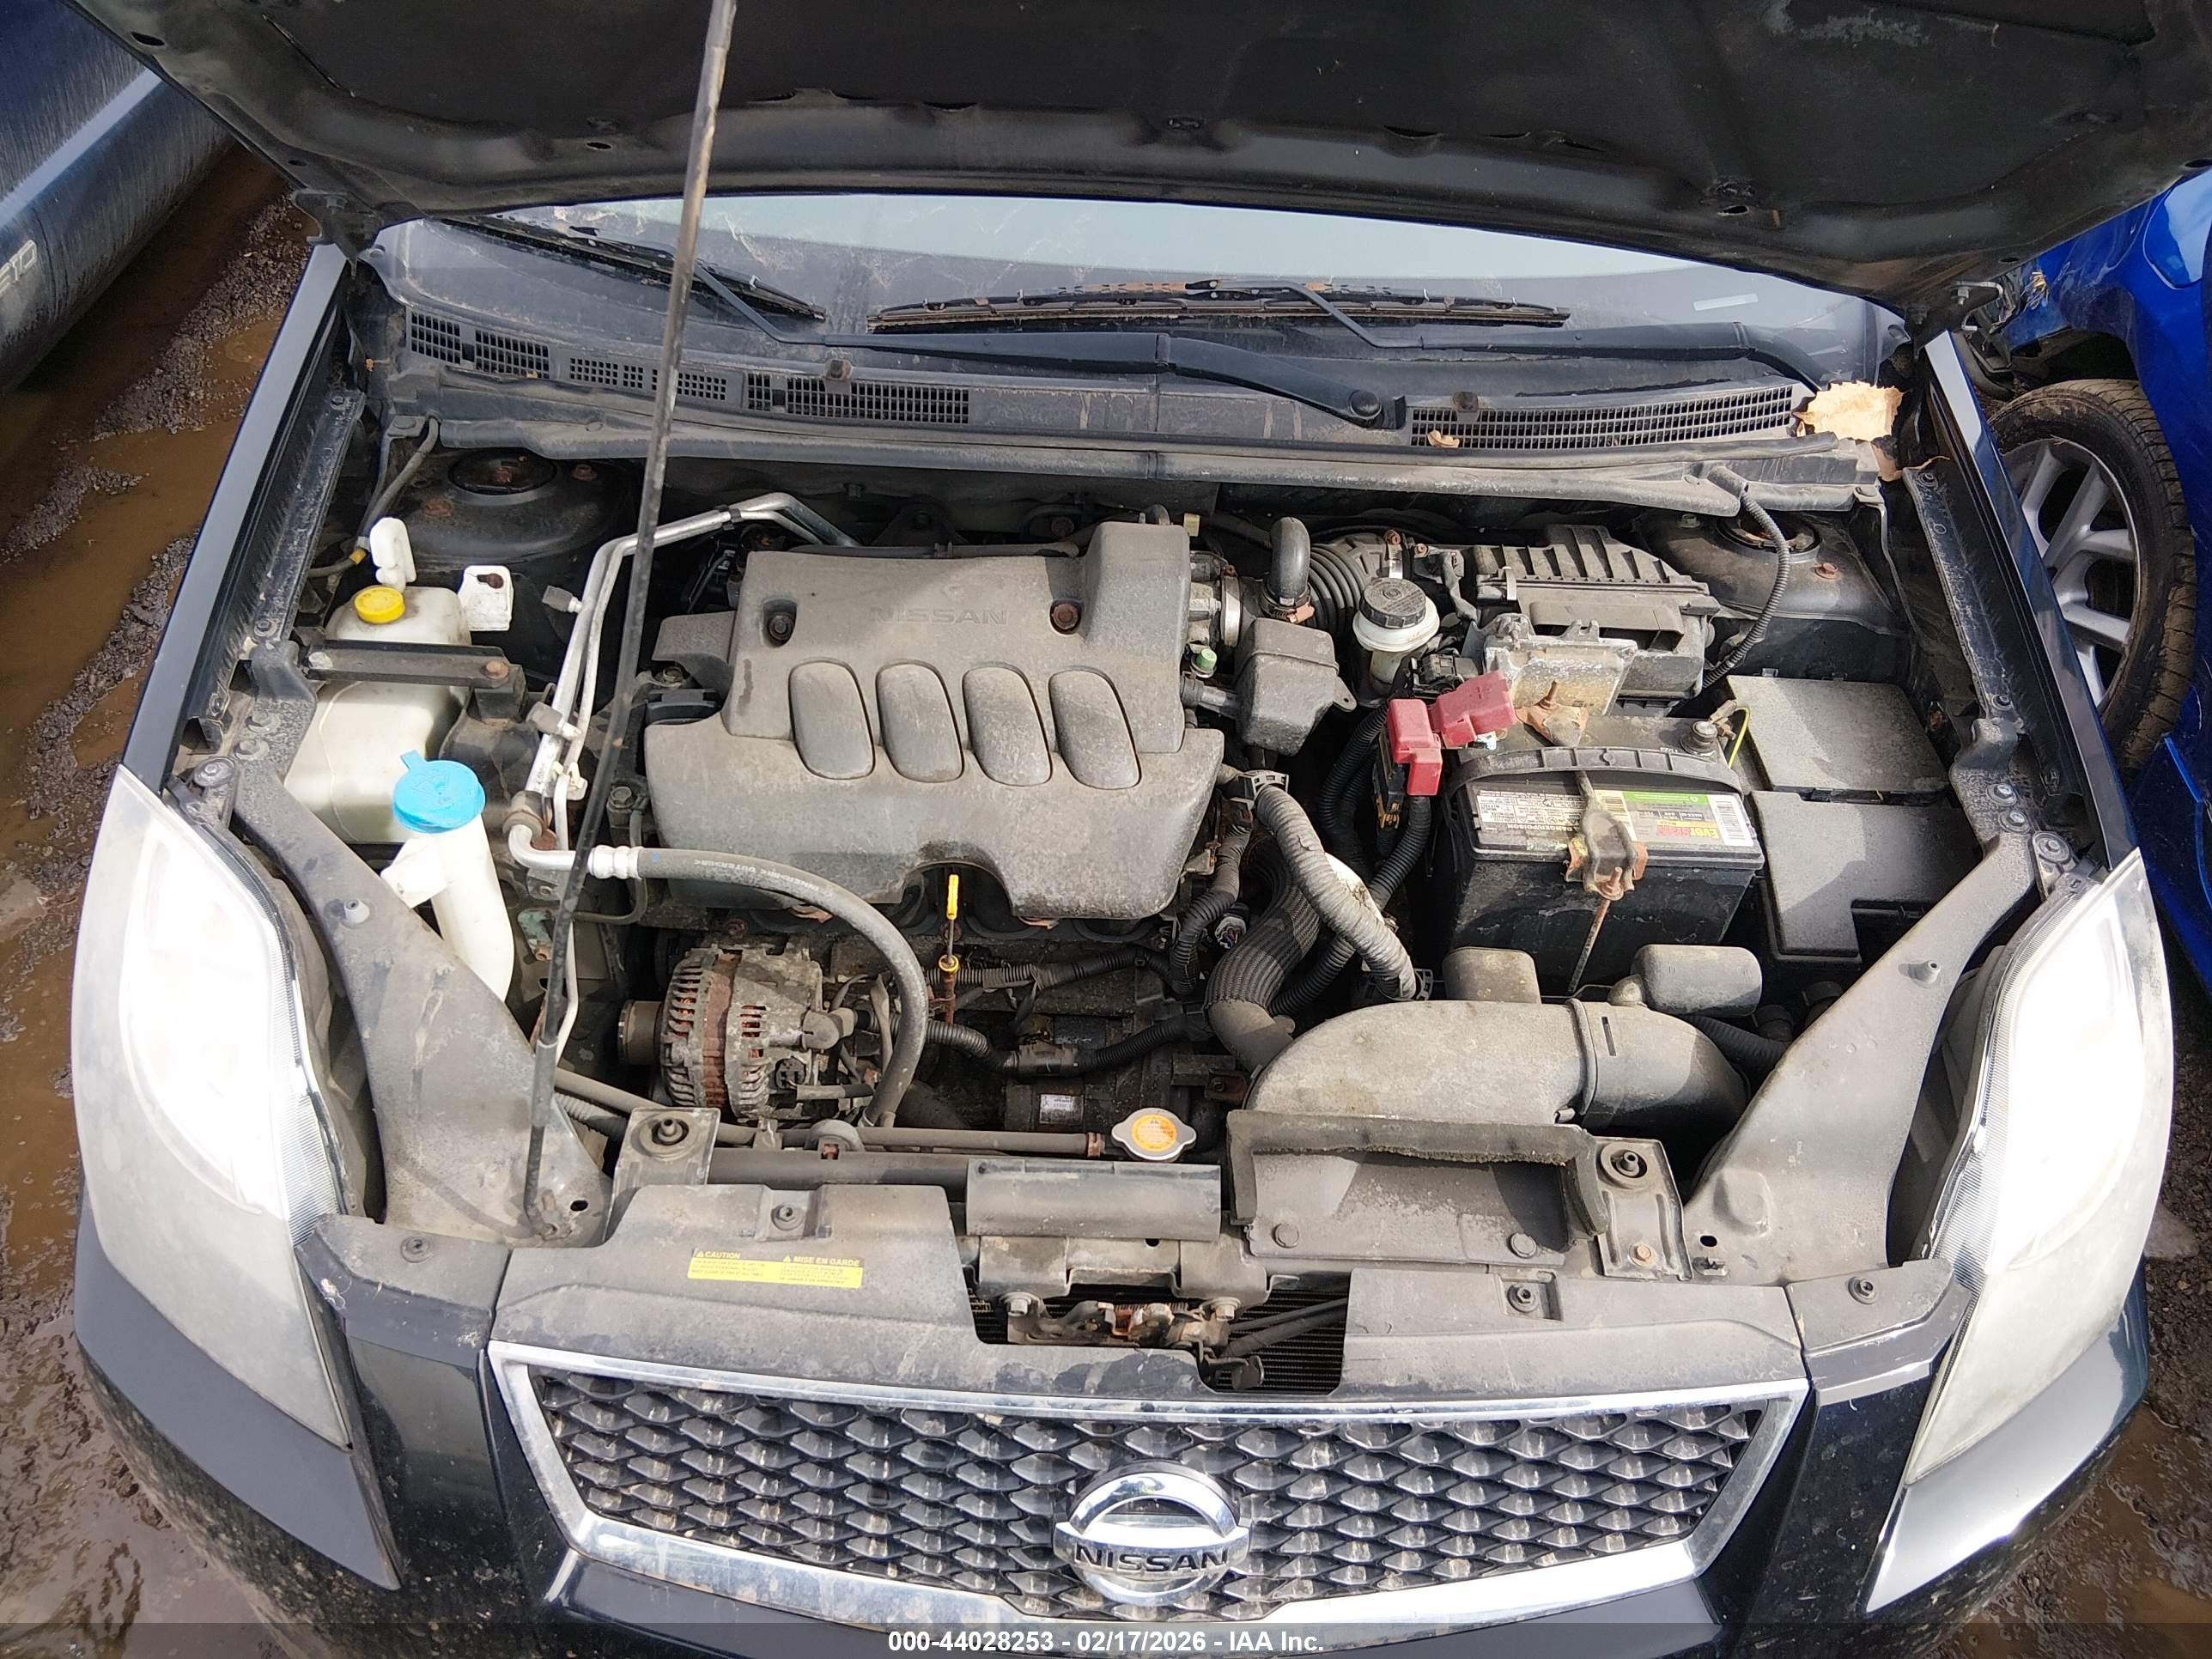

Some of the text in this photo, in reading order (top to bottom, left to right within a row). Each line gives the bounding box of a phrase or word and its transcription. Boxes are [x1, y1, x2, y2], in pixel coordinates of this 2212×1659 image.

[869, 606, 1008, 625] NISSAN
[704, 1250, 741, 1260] CAUTION
[793, 1255, 860, 1267] MISE EN GARDE
[1073, 1542, 1229, 1572] NISSAN
